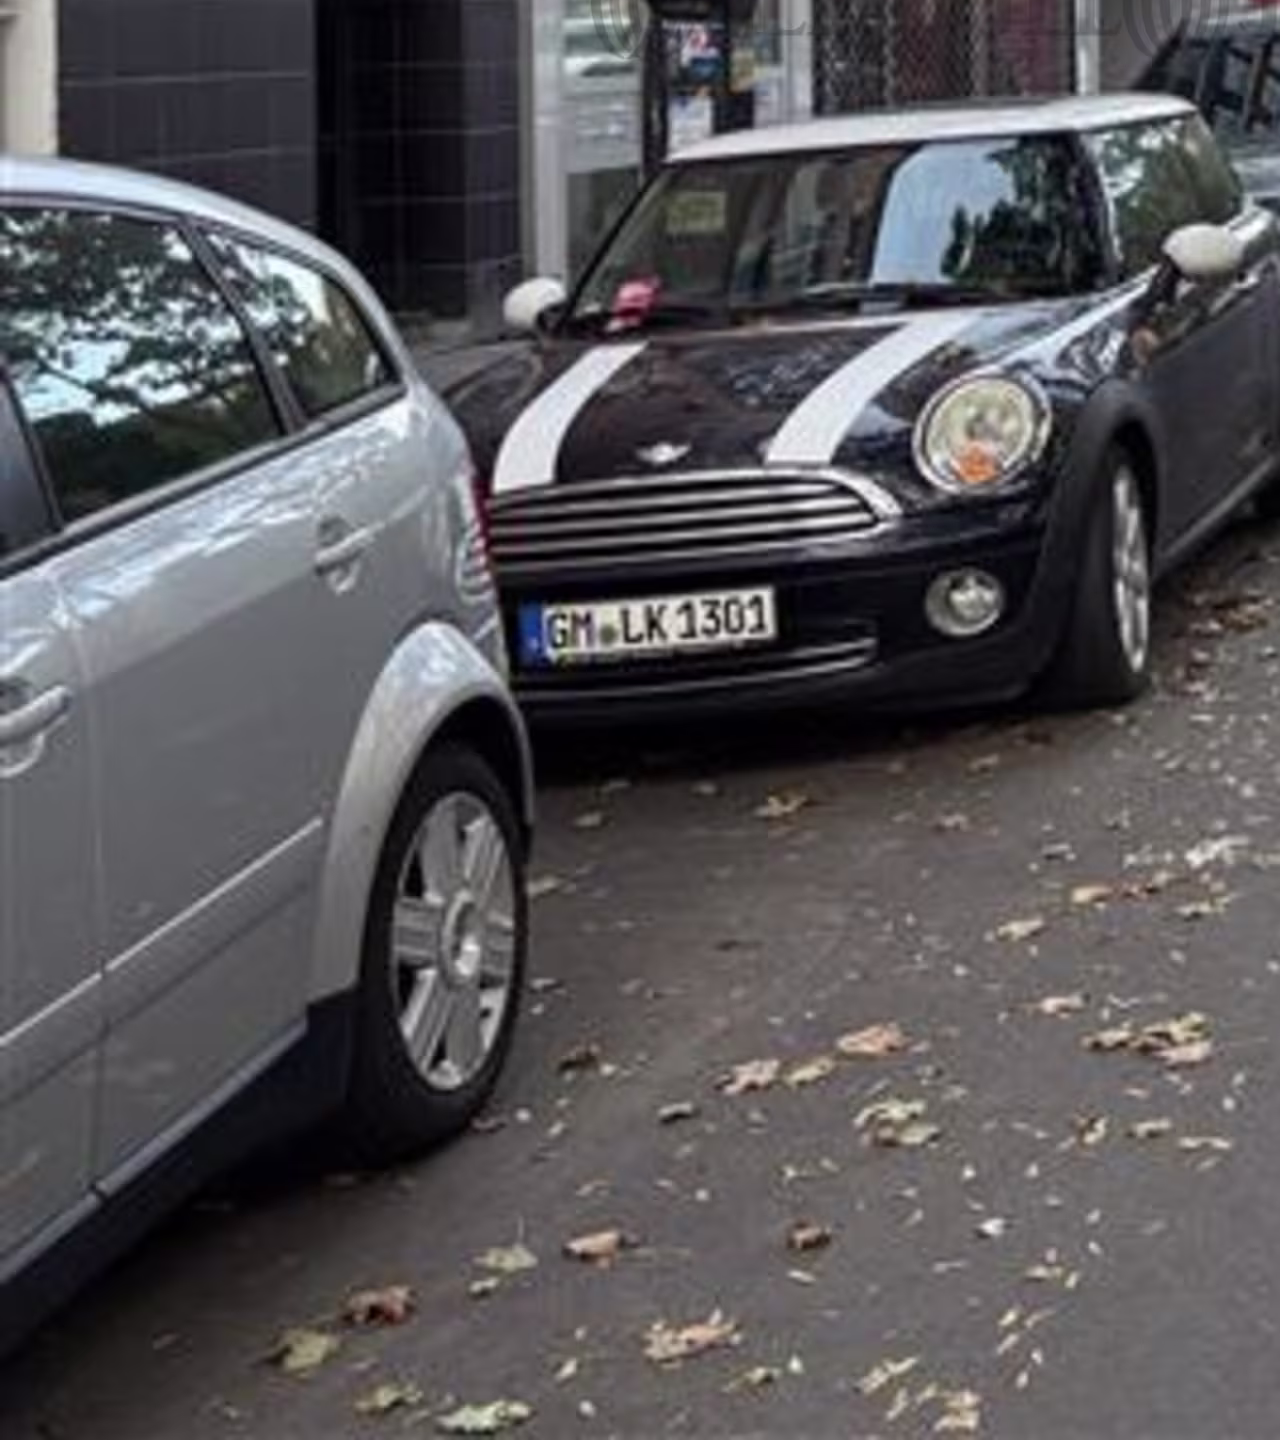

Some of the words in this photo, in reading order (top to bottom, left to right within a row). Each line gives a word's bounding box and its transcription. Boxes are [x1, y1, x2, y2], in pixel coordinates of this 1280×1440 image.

[546, 611, 594, 649] GM
[622, 604, 673, 644] LK
[677, 594, 768, 640] 1301
